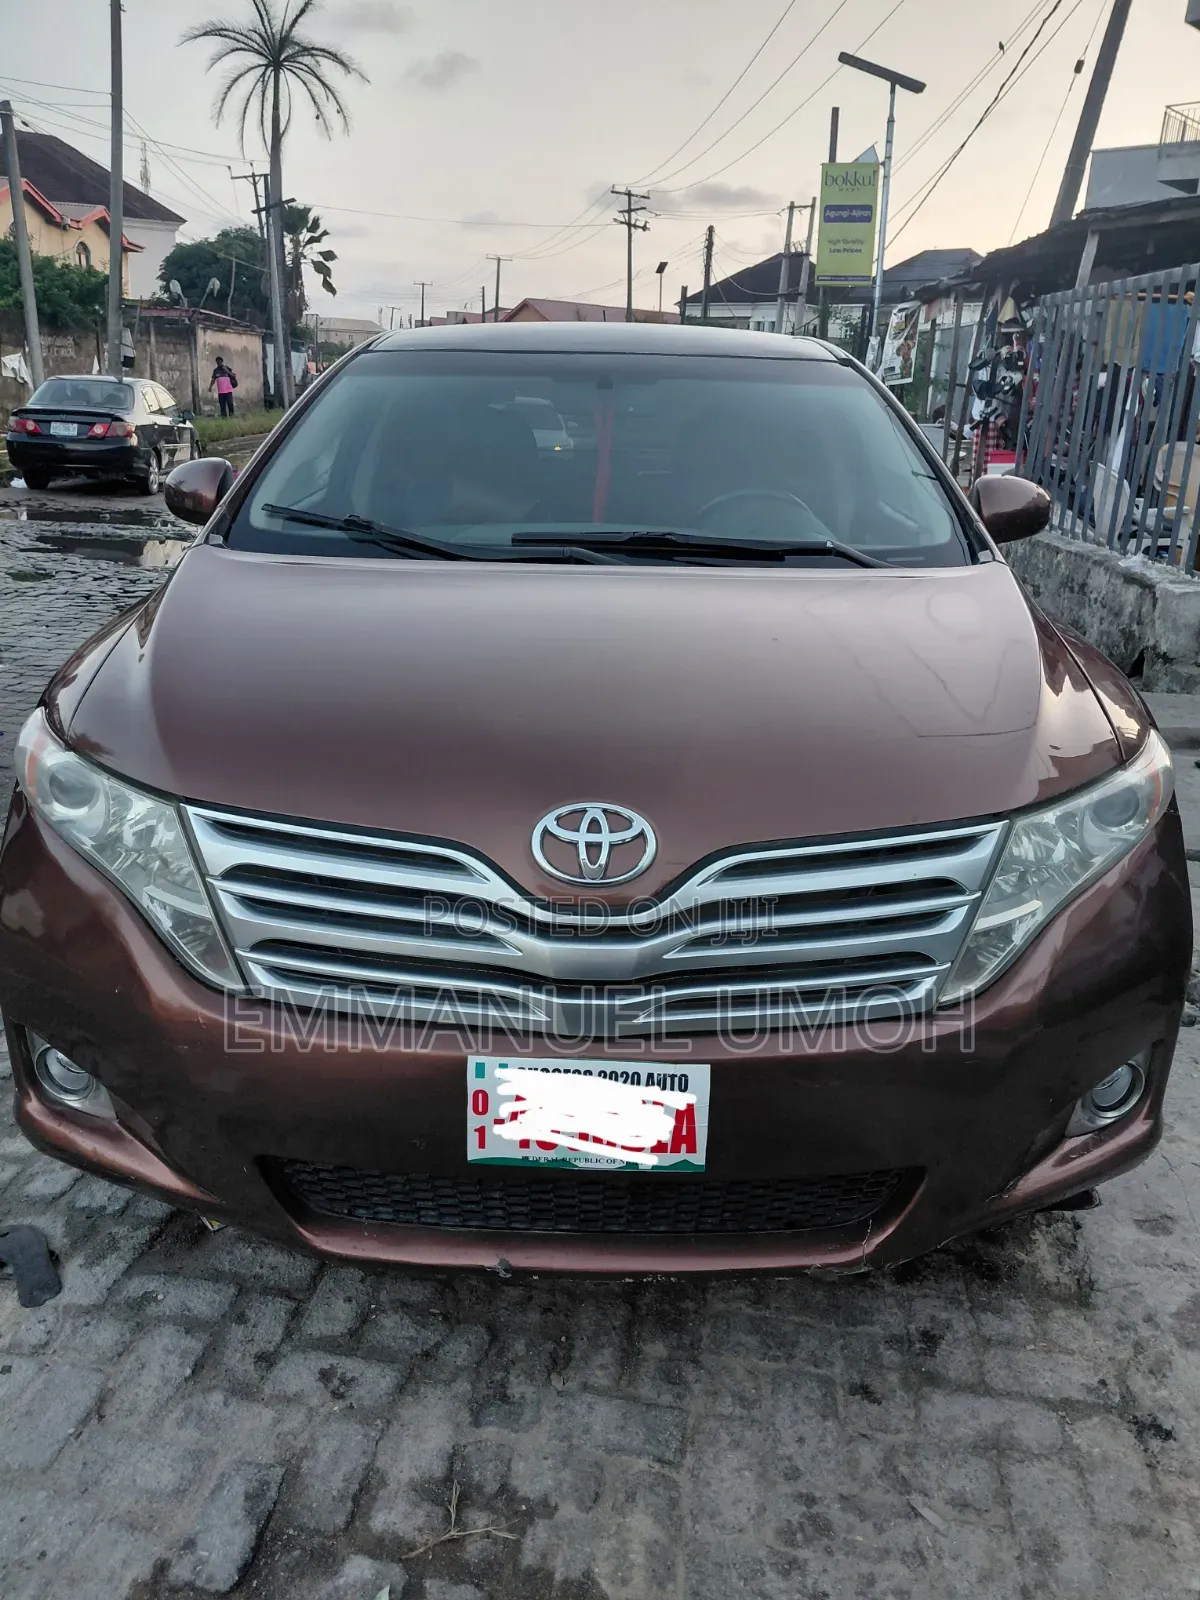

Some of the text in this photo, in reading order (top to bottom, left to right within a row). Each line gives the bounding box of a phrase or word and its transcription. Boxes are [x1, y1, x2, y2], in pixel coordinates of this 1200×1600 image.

[825, 170, 877, 187] bokku!
[645, 1072, 689, 1092] AUTO
[521, 1155, 558, 1163] FEDERAL
